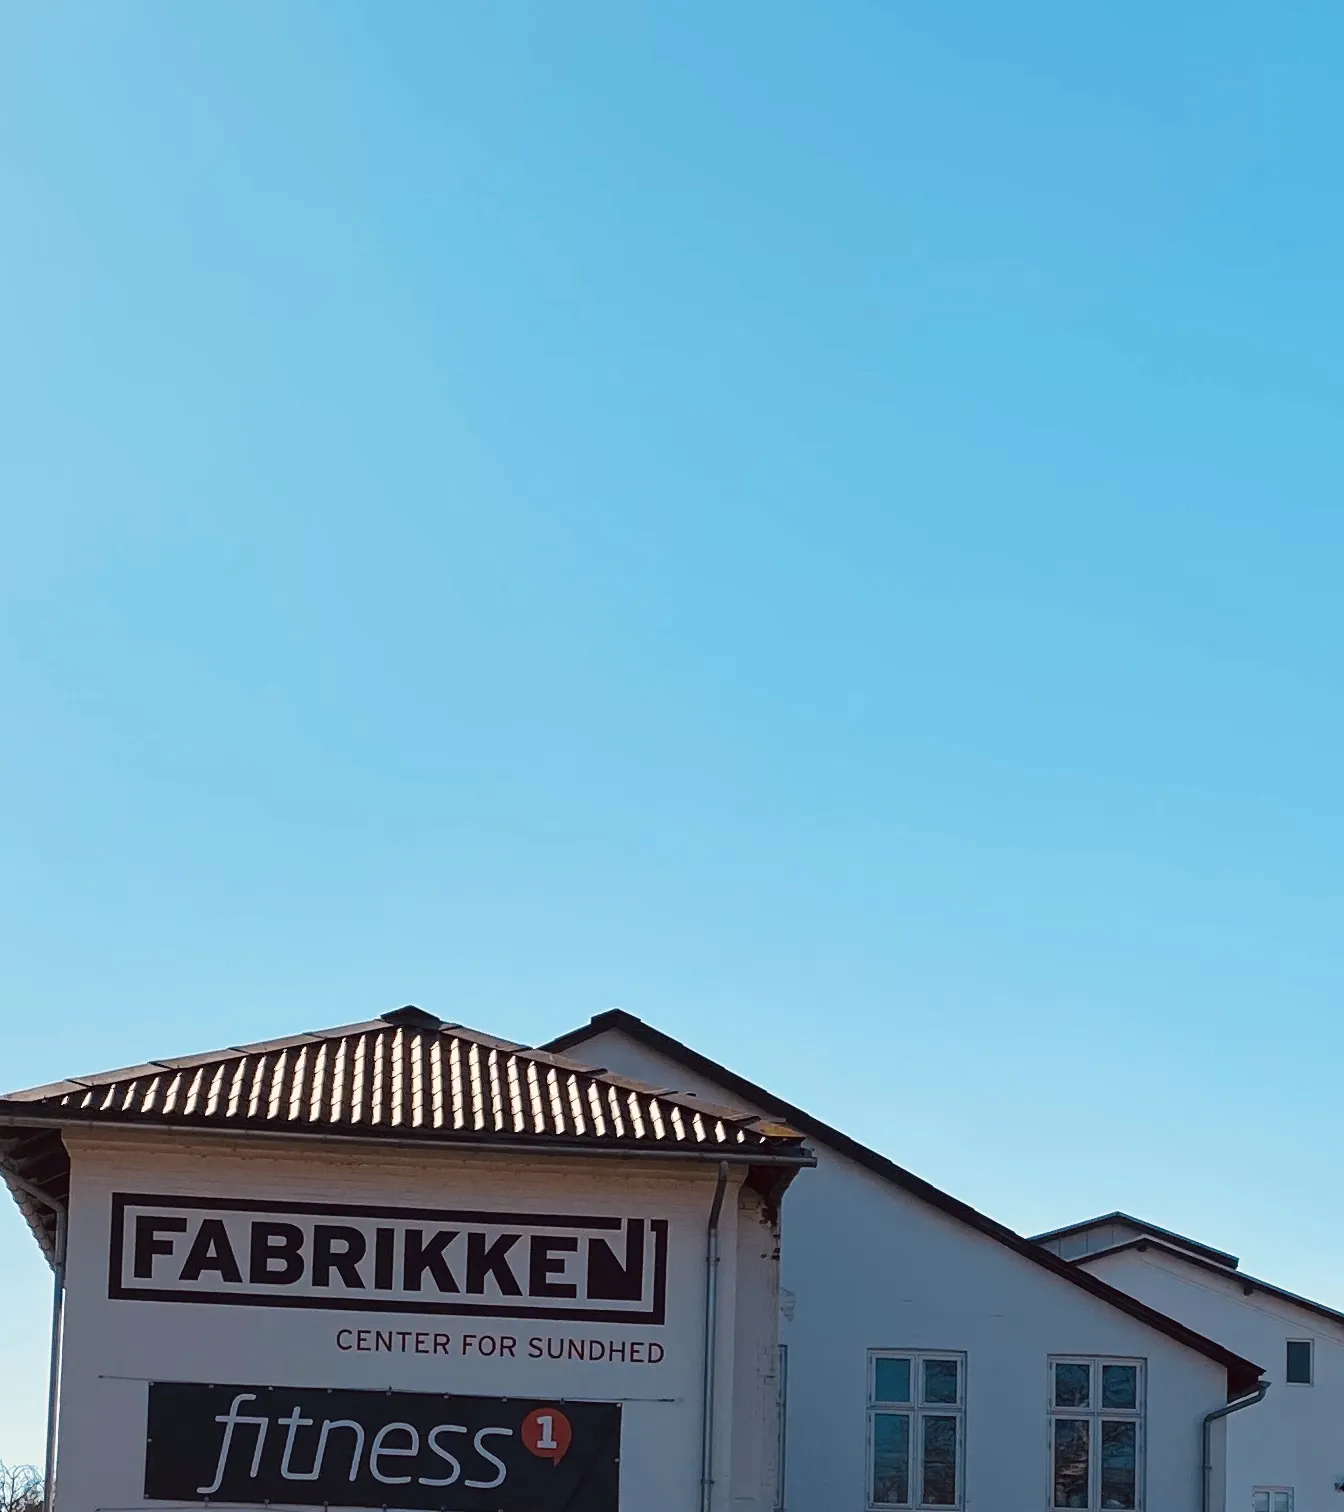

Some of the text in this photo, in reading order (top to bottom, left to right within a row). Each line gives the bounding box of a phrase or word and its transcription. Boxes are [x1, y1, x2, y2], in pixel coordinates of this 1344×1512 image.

[133, 1215, 645, 1302] FABRIKKEN
[336, 1330, 665, 1364] CENTER FOR SUNDHED
[197, 1393, 513, 1495] fitness
